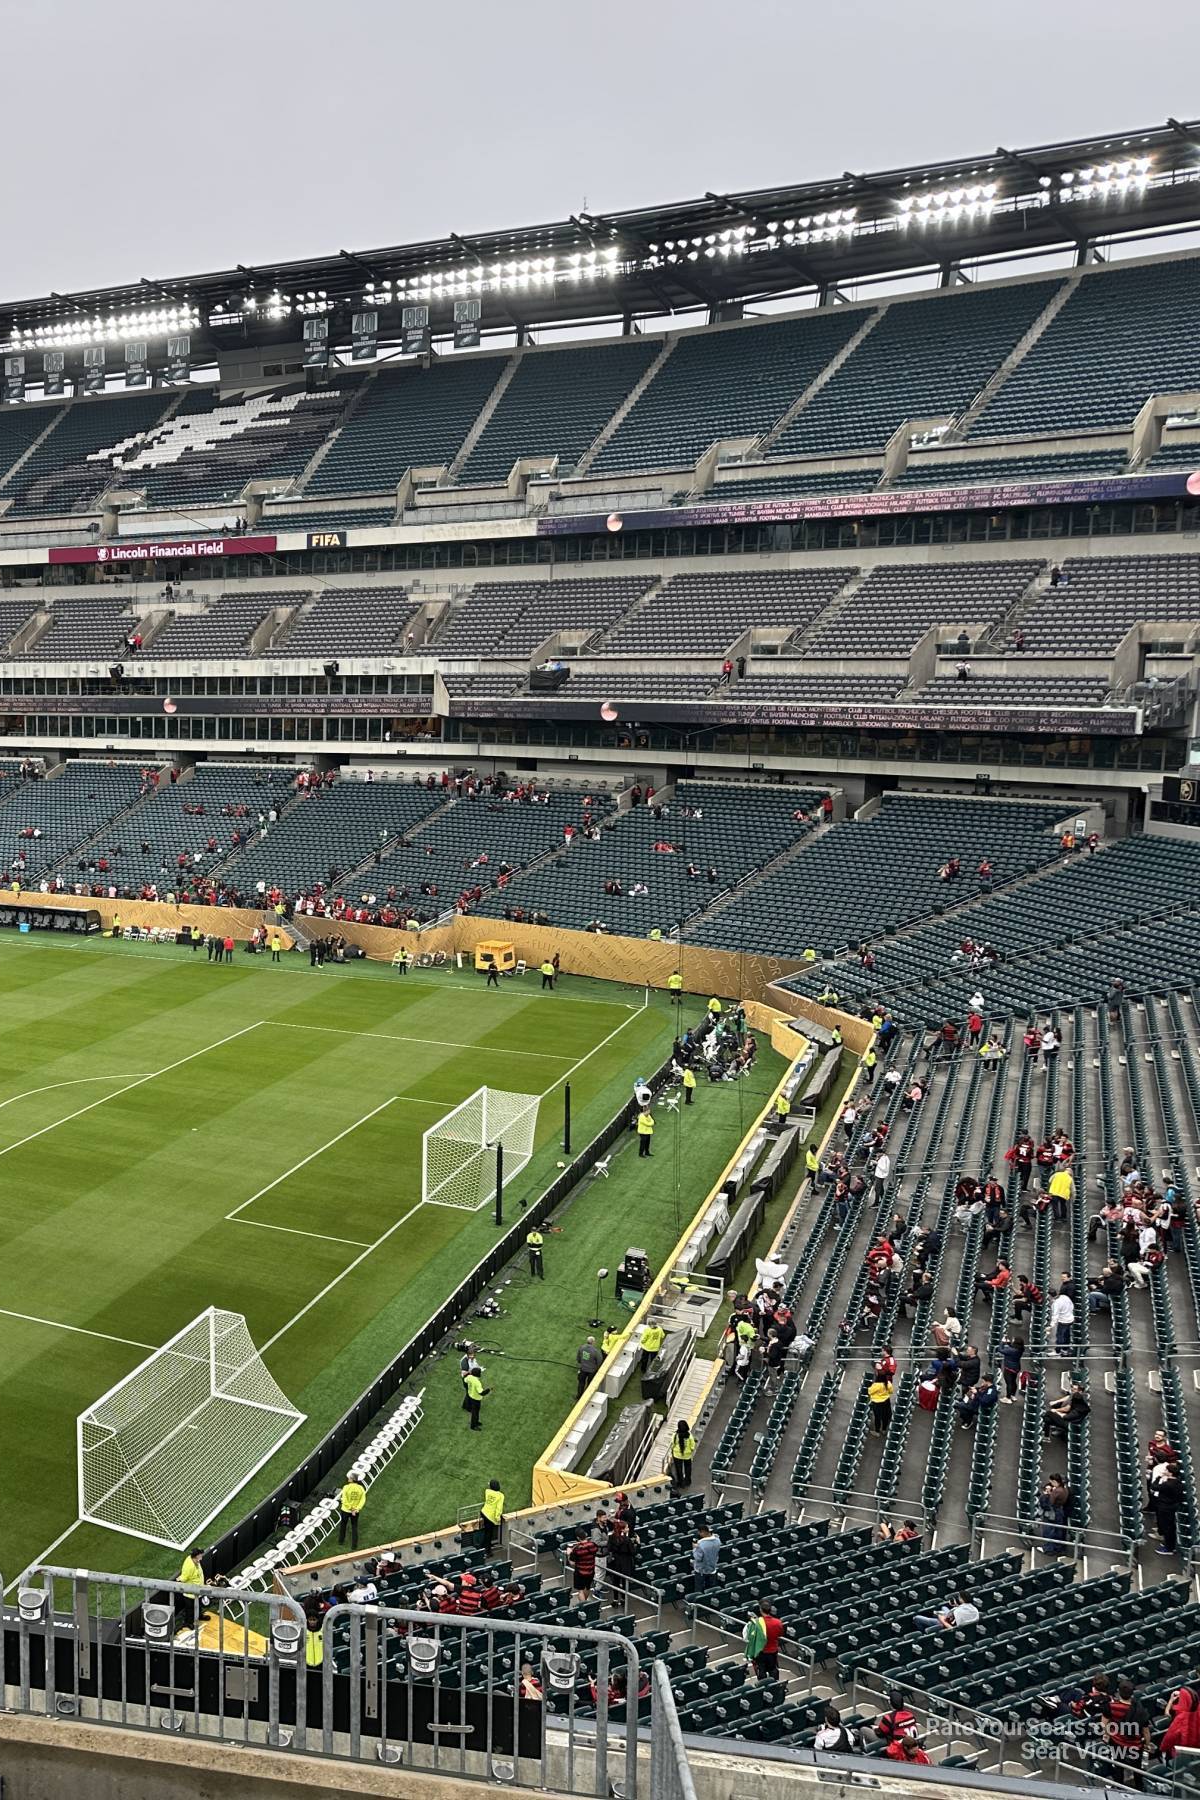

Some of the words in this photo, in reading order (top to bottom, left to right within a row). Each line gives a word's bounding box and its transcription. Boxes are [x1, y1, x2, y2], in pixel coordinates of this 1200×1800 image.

[404, 308, 427, 328] 99
[456, 301, 480, 322] 20
[305, 320, 326, 340] 15
[354, 314, 375, 334] 40
[170, 338, 189, 357] 70
[86, 348, 104, 367] 44
[10, 359, 19, 376] 5
[111, 546, 147, 559] Lincoln
[150, 543, 195, 557] Financial
[197, 541, 224, 555] Field
[311, 534, 340, 547] FIFA
